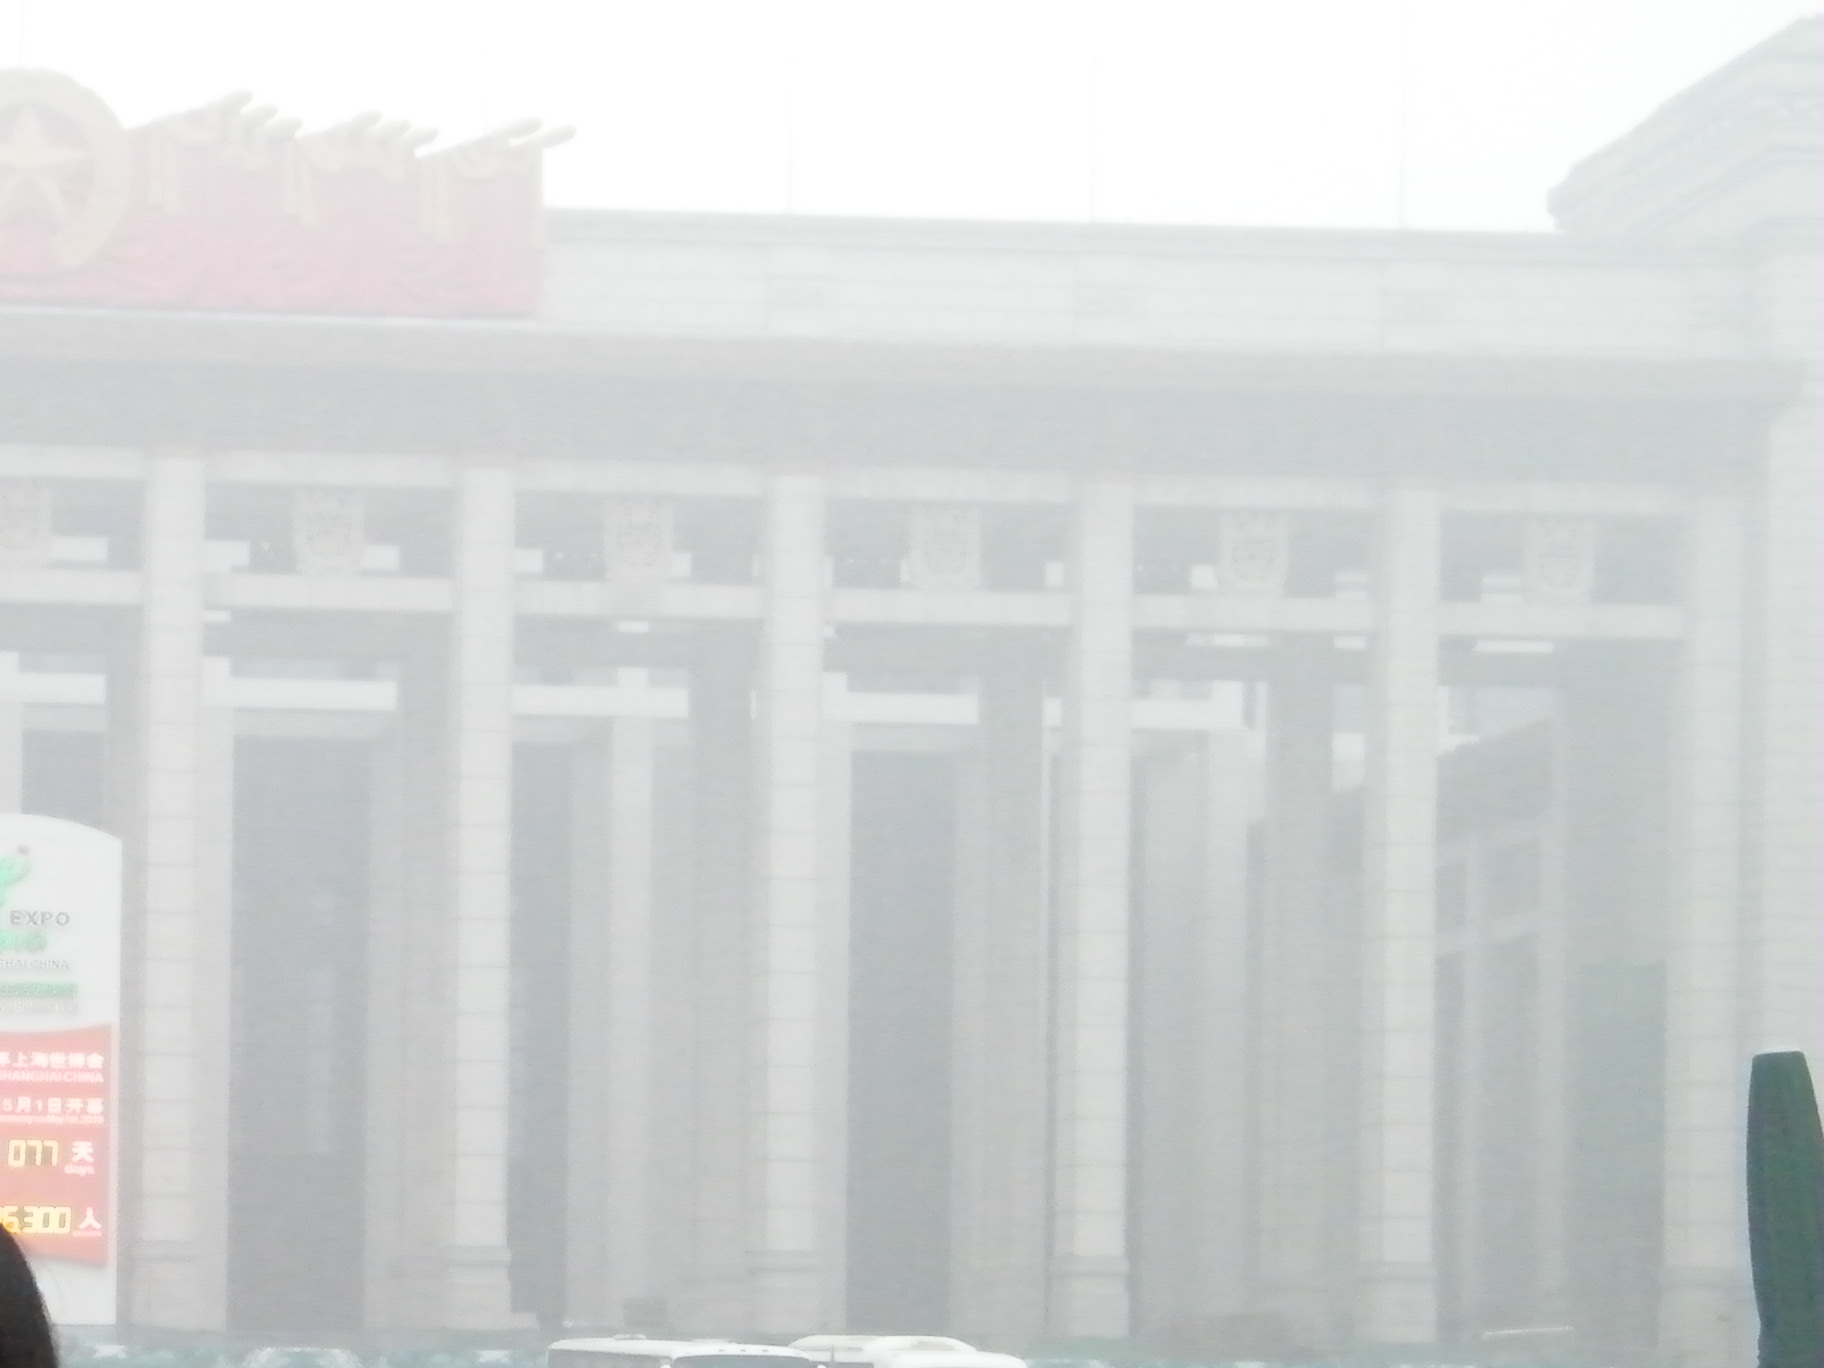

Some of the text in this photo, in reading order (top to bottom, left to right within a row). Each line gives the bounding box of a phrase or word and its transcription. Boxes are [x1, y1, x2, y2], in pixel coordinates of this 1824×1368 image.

[10, 910, 71, 927] EXPO
[30, 958, 70, 971] CHINA
[64, 1071, 105, 1084] CHINA
[8, 1139, 58, 1167] 077
[71, 1141, 95, 1163] 天
[64, 1164, 95, 1177] days
[78, 1206, 103, 1230] 人
